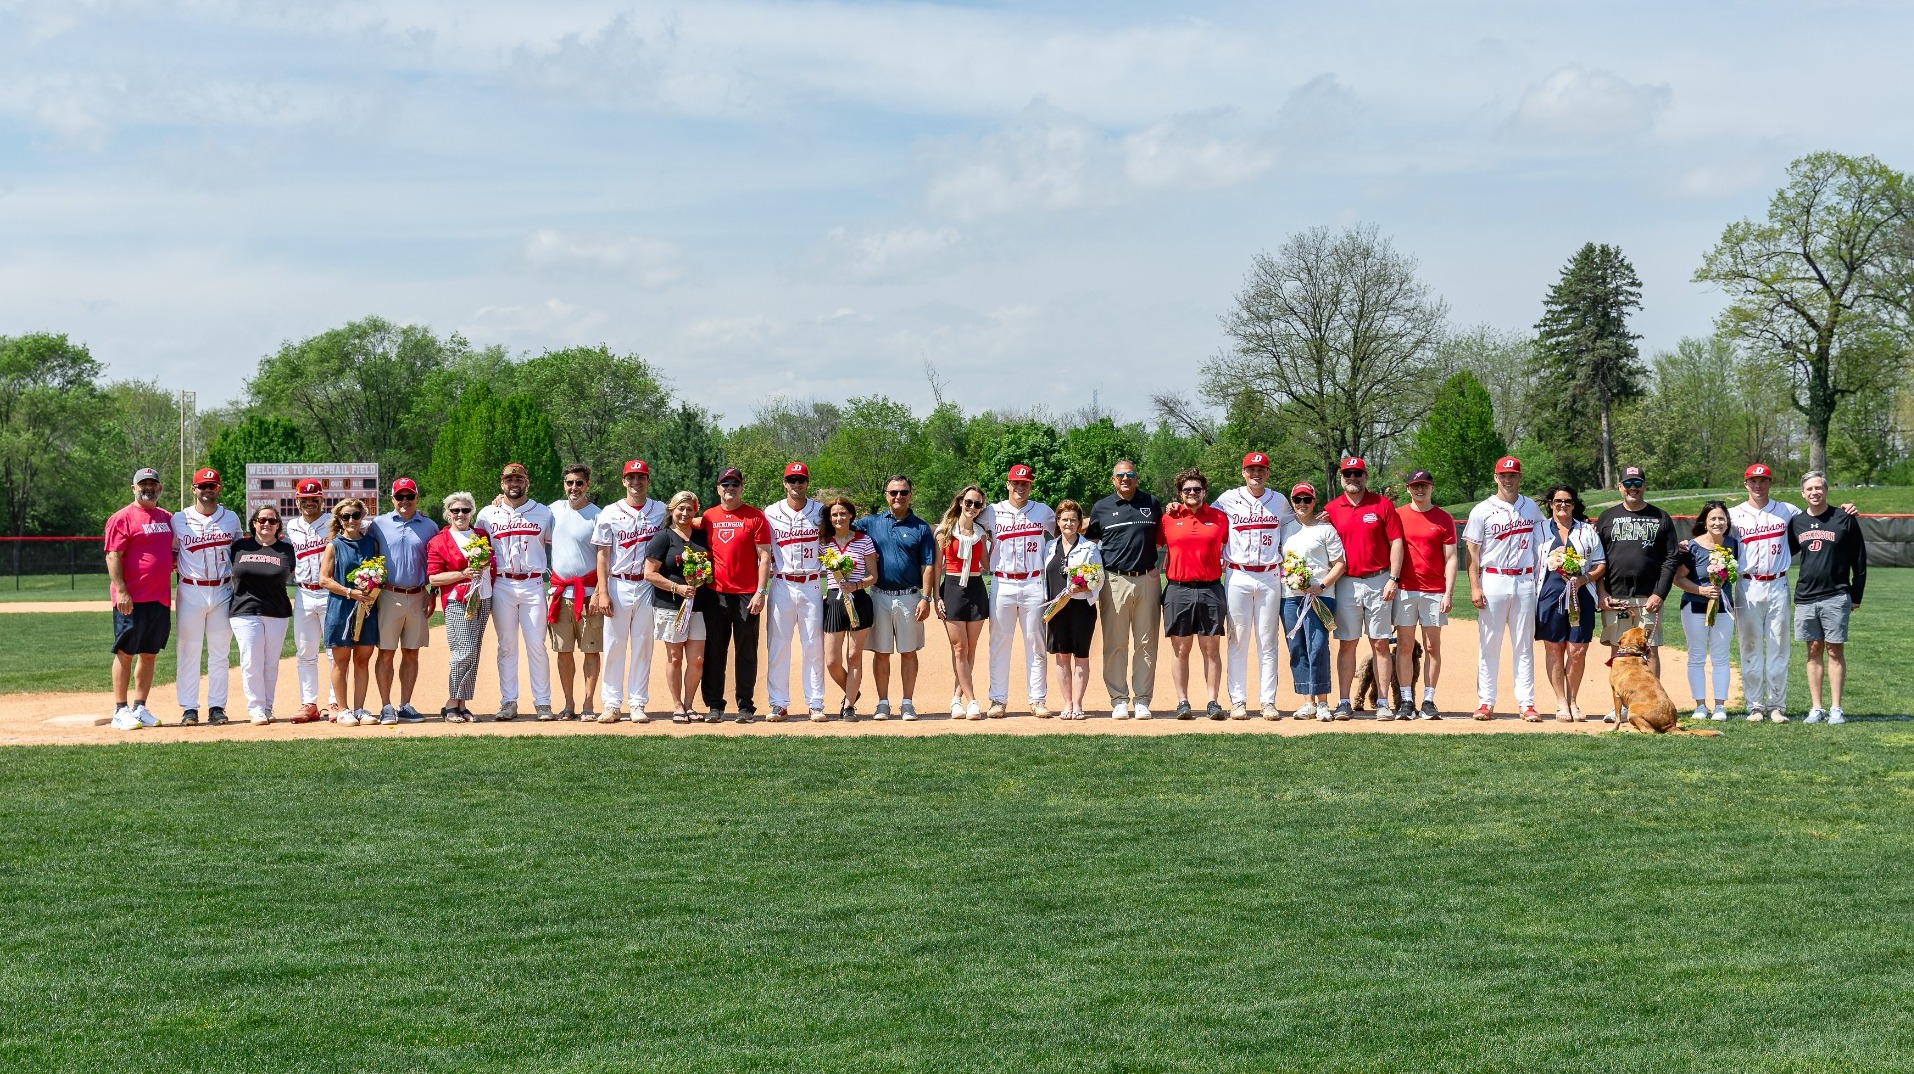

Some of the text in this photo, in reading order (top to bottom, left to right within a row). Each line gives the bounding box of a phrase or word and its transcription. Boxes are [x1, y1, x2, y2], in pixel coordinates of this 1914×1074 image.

[248, 466, 289, 474] WELCOME
[292, 466, 304, 474] TO
[351, 466, 376, 474] FIELD
[1232, 514, 1279, 526] Dickinson
[490, 522, 540, 534] Dickinson
[995, 522, 1043, 534] Dickinson
[1492, 519, 1534, 536] Dickinson
[1611, 522, 1660, 541] ARMY
[1738, 522, 1786, 538] Dickinson
[184, 532, 232, 546] Dickinson
[774, 528, 819, 540] Dickinson
[1798, 530, 1835, 543] DICKINSON
[524, 541, 528, 551] 7
[1262, 535, 1272, 546] 25
[804, 548, 813, 558] 21
[1026, 542, 1037, 552] 22
[1772, 544, 1782, 555] 32
[220, 551, 225, 561] 1
